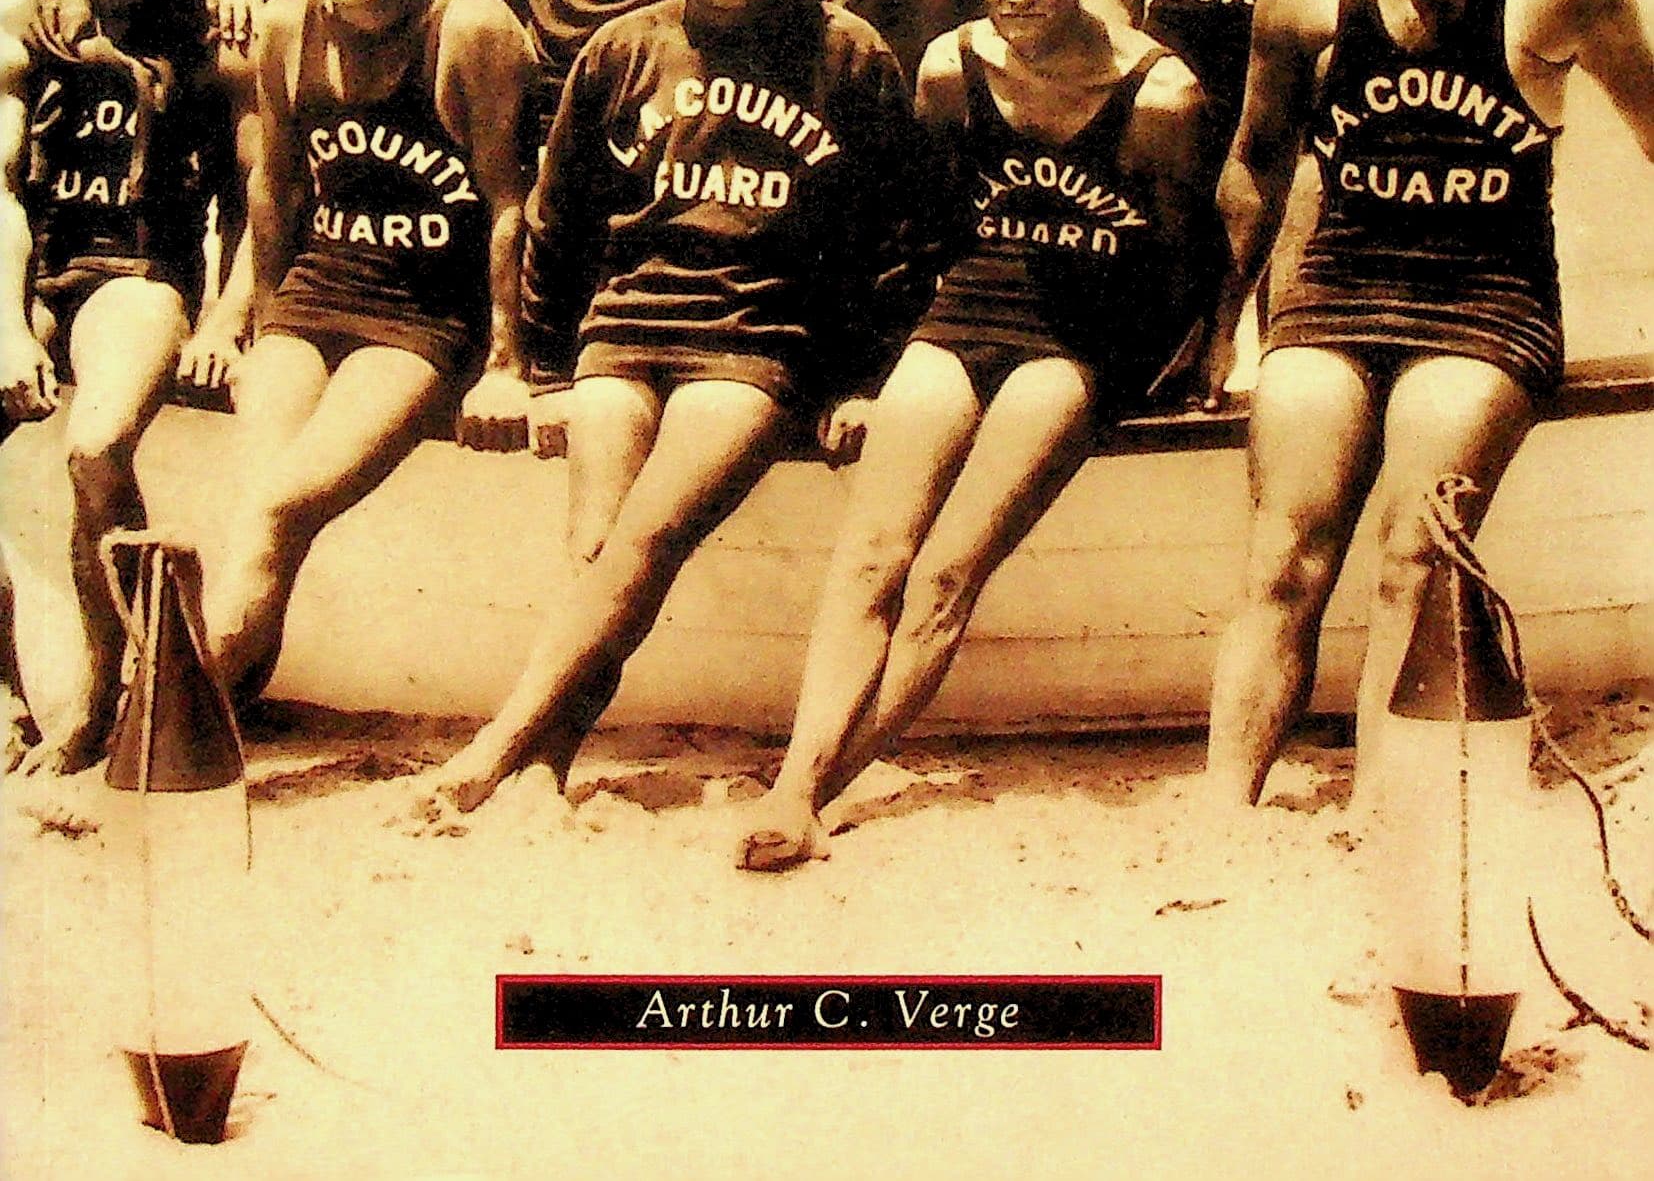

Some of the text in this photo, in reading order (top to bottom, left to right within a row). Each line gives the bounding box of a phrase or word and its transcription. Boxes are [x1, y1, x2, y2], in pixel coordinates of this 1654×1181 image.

[673, 76, 841, 167] COUNTY
[1364, 67, 1549, 155] COUNTY
[310, 120, 480, 204] COUNTY
[1002, 156, 1148, 228] COUNTY
[635, 988, 1020, 1039] Arthur C. Verge
